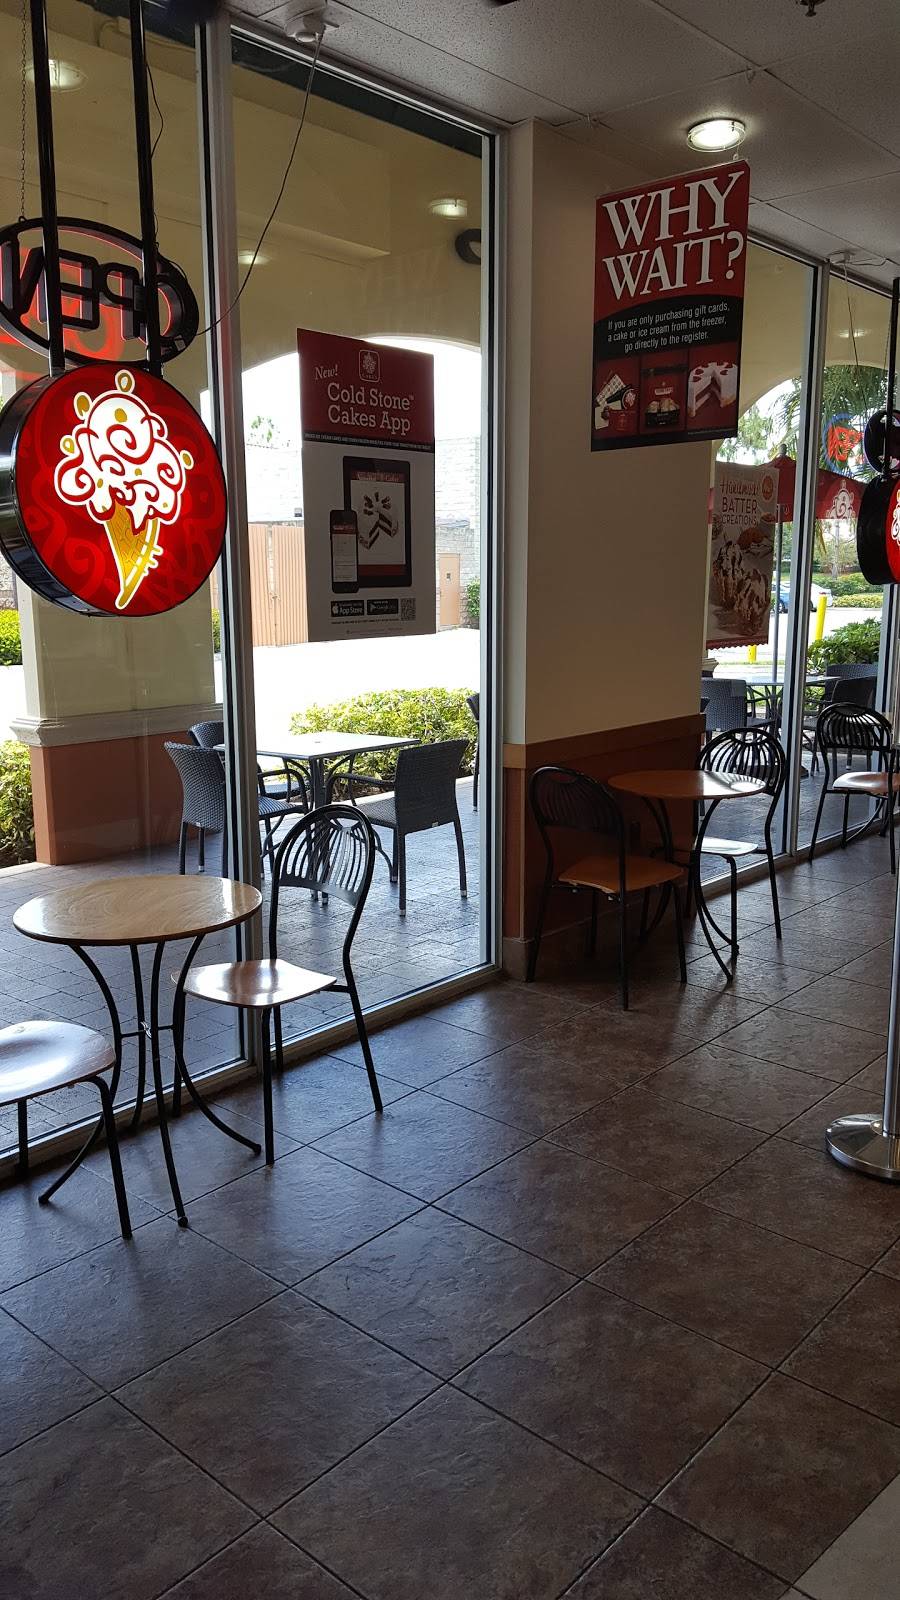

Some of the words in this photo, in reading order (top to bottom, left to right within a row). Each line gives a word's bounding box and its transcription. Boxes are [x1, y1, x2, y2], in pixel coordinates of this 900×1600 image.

[602, 171, 744, 249] WHY
[602, 230, 744, 301] WAIT?
[608, 321, 613, 330] If
[614, 320, 626, 331] you
[627, 317, 638, 327] are
[639, 314, 654, 326] only
[655, 308, 693, 323] purchasing
[694, 304, 707, 318] gift
[708, 301, 730, 313] cards,
[608, 334, 612, 342] a
[613, 331, 628, 342] cake
[629, 329, 636, 339] or
[638, 327, 648, 337] ice
[649, 324, 670, 336] cream
[671, 321, 687, 332] from
[689, 319, 700, 329] the
[701, 315, 727, 327] freezer,
[624, 342, 633, 354] go
[634, 337, 659, 350] directly
[660, 336, 668, 346] to
[669, 334, 680, 345] the
[681, 331, 709, 344] register.
[315, 364, 338, 380] New!
[327, 382, 366, 405] Cold
[328, 404, 376, 428] Cakes
[380, 411, 411, 436] App
[722, 496, 758, 514] BATTER
[722, 514, 757, 526] CREATIONS
[340, 607, 350, 615] App
[350, 606, 364, 614] Store
